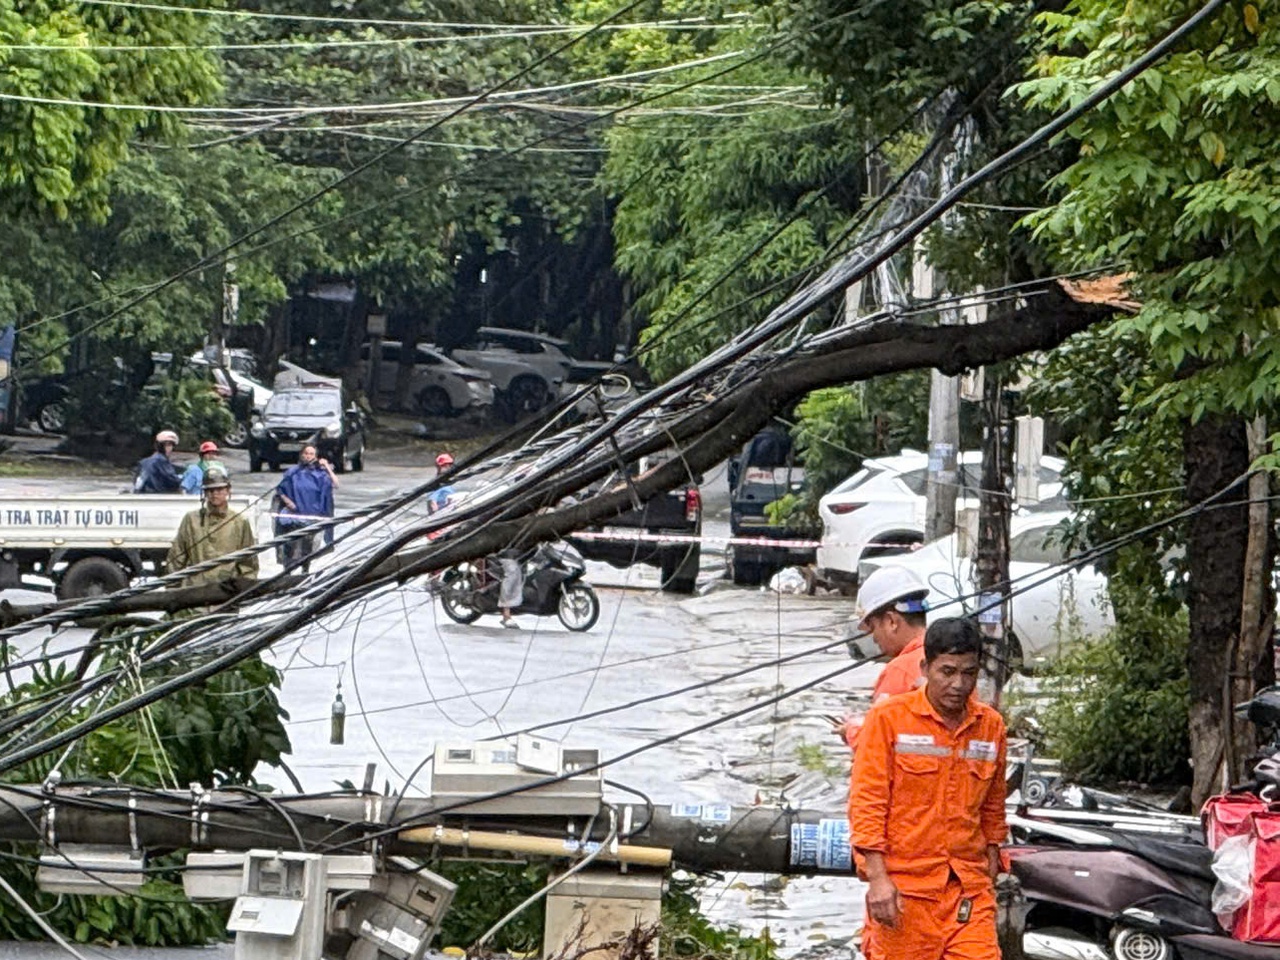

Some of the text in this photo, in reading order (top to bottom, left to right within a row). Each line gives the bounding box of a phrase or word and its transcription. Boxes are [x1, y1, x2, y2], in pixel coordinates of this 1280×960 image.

[6, 509, 32, 525] TRA
[74, 508, 92, 528] TỰ
[117, 509, 139, 528] THỊ
